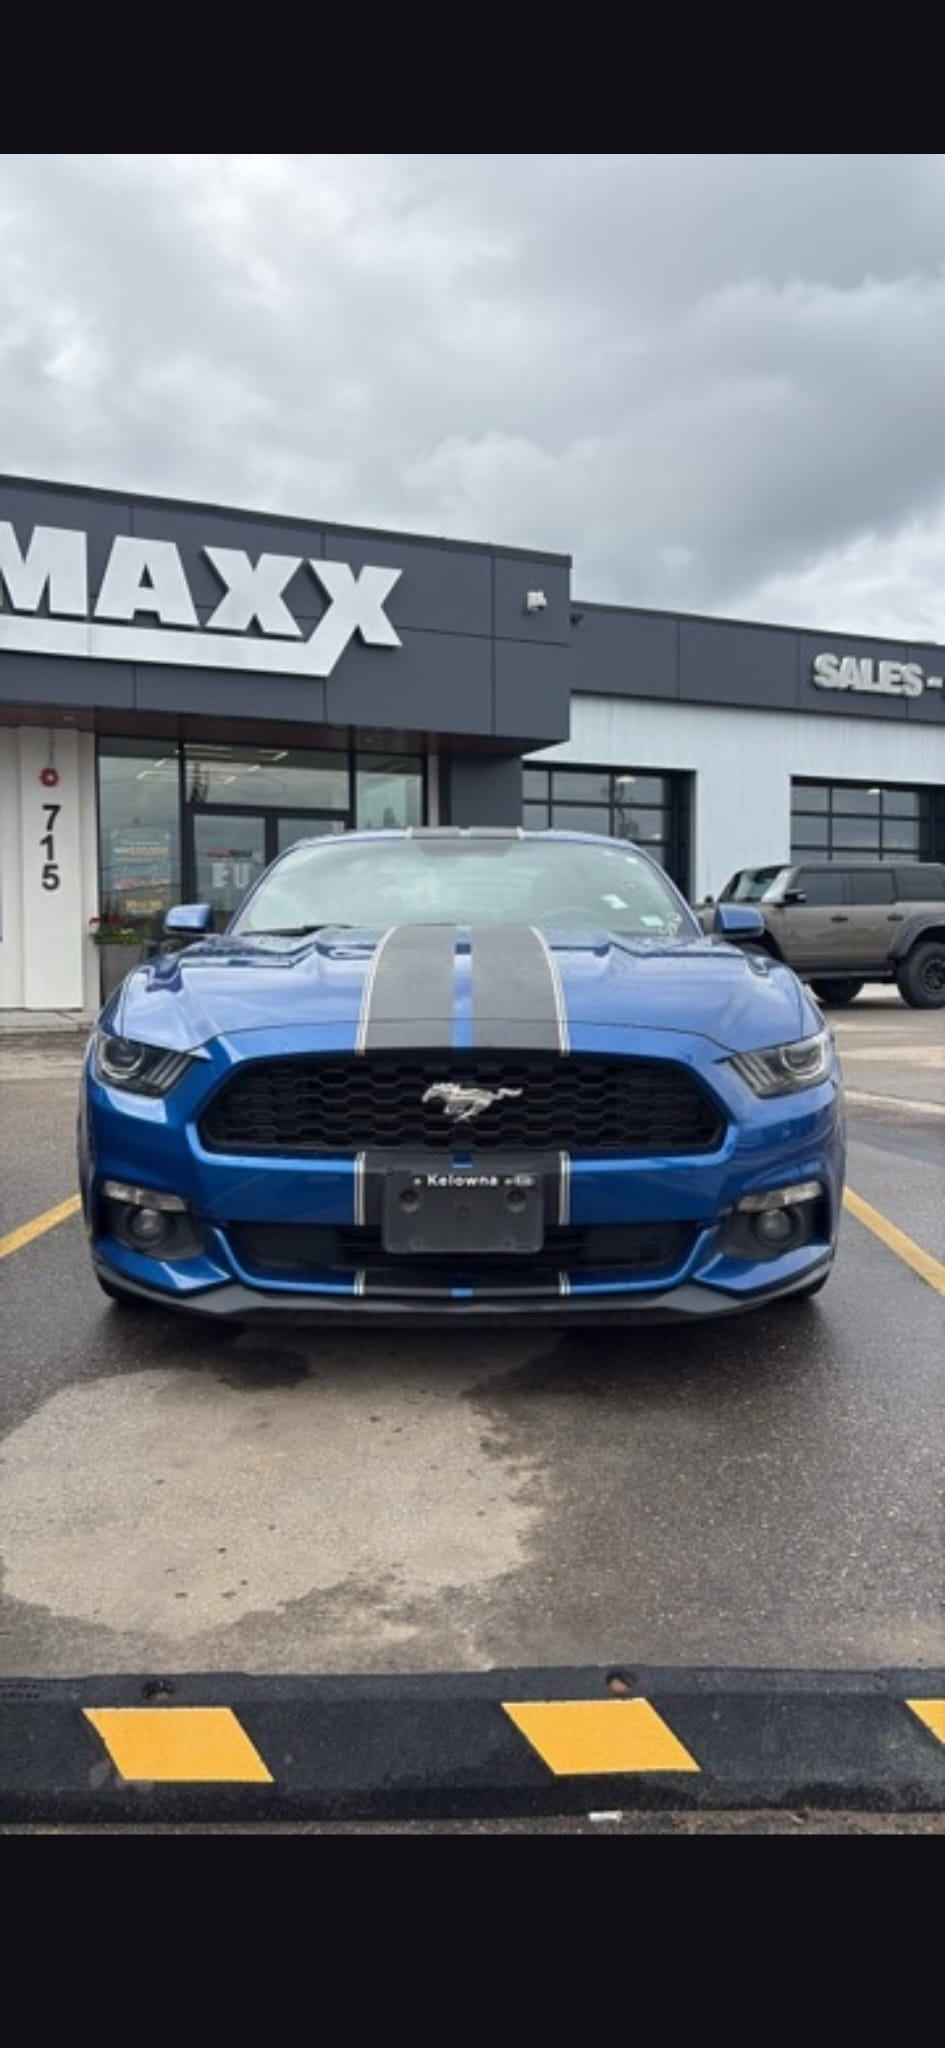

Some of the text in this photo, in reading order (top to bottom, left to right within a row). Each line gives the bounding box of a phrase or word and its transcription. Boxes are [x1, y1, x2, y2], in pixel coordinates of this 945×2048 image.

[0, 520, 402, 676] MAXX
[813, 653, 924, 697] SALES
[39, 804, 61, 891] 715
[427, 1174, 498, 1187] Kelowna
